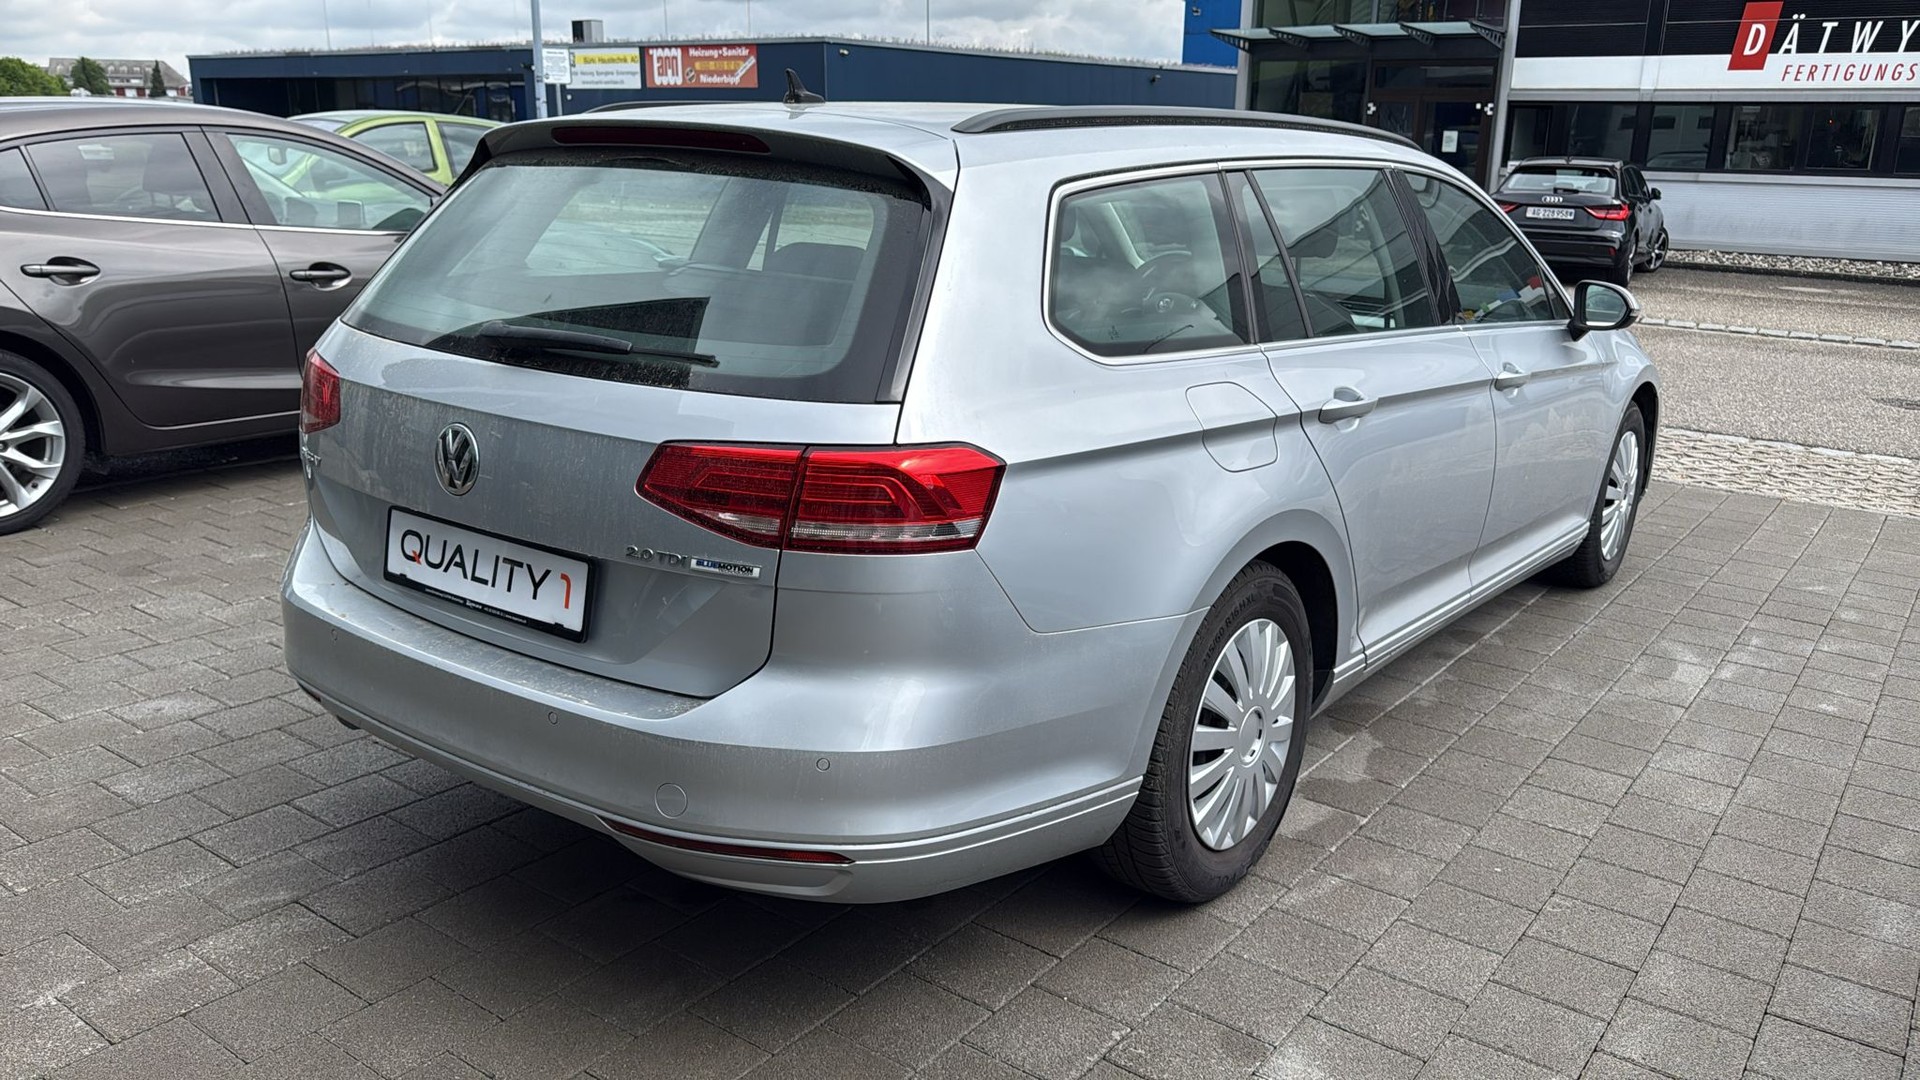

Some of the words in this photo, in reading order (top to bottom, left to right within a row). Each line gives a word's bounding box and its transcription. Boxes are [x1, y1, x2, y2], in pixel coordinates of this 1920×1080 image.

[1781, 63, 1918, 82] FERTIGUNGS
[401, 529, 552, 600] QUALITY
[626, 544, 654, 561] 2.0
[656, 550, 688, 568] TDI
